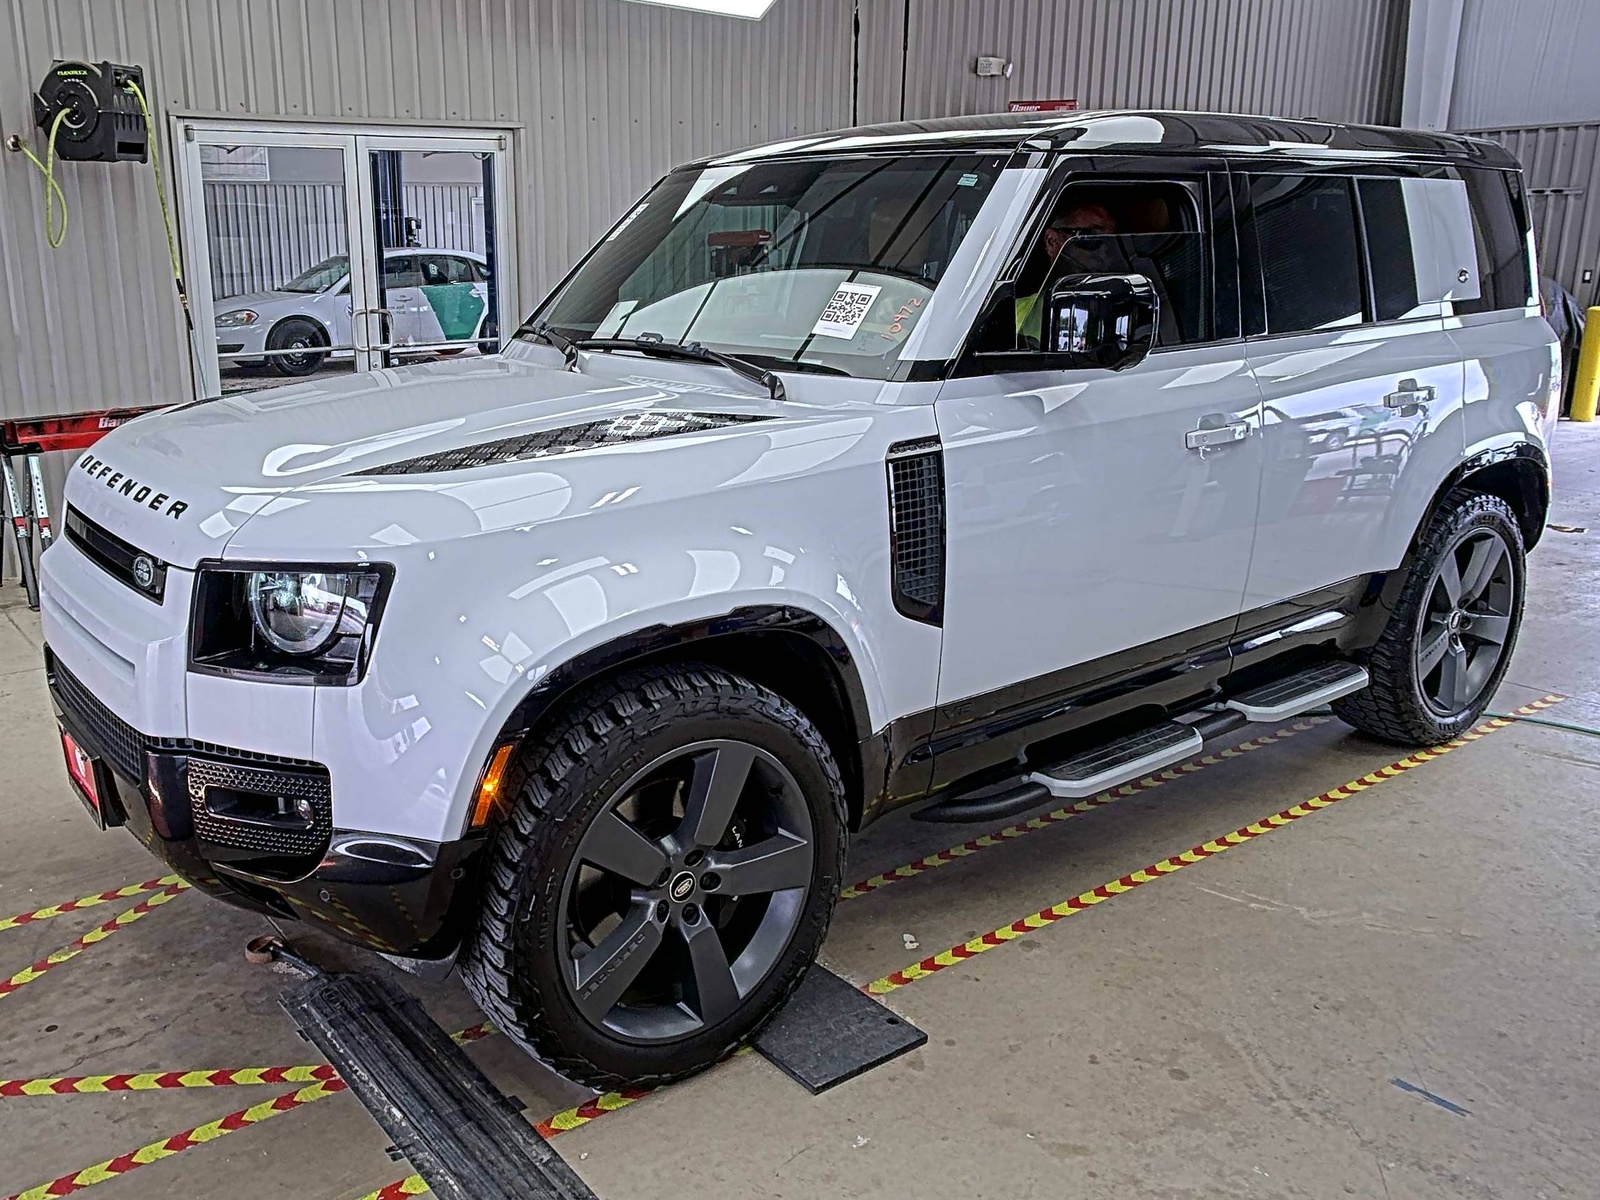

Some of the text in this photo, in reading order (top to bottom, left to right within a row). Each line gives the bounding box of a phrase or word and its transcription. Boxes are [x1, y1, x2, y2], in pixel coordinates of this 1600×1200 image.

[1011, 104, 1041, 112] Bauer
[98, 417, 130, 429] Bau
[80, 454, 189, 520] DEFENDER
